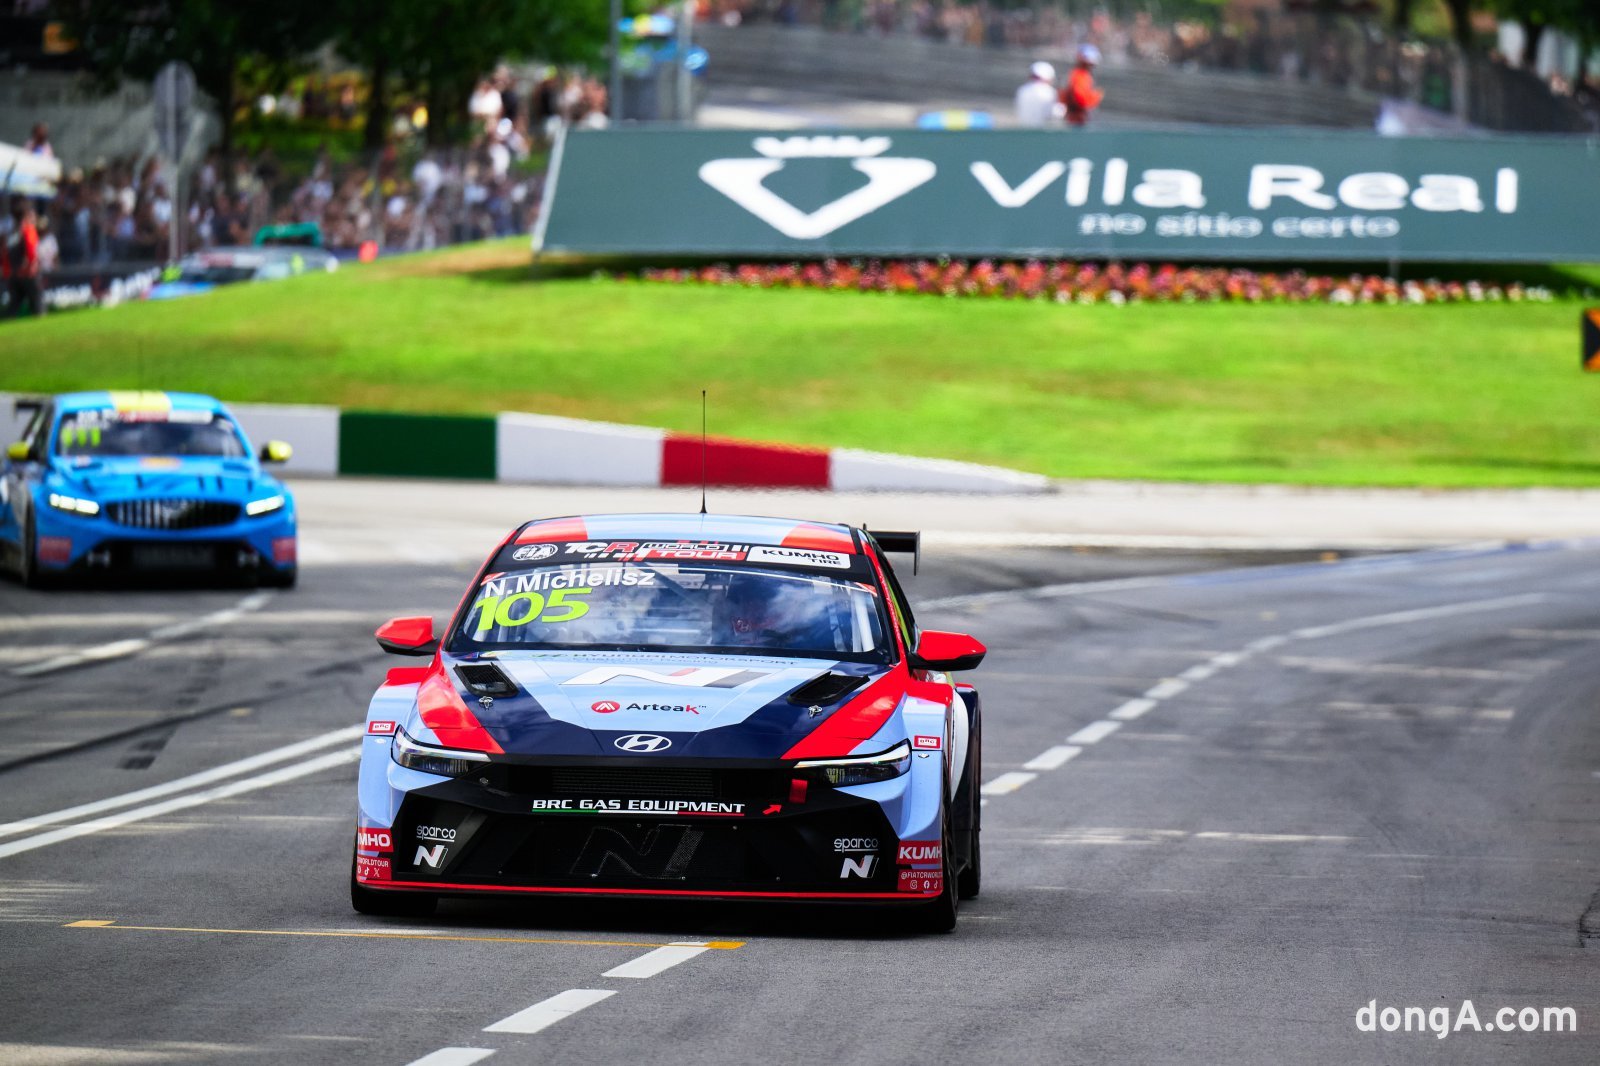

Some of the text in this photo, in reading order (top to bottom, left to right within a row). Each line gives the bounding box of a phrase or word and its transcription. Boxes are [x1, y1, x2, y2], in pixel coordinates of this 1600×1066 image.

[969, 156, 1519, 214] Vila Real
[1271, 214, 1400, 239] certo
[565, 542, 639, 554] TCR
[655, 550, 738, 560] TOUR
[762, 550, 840, 561] KUMHO
[808, 558, 842, 566] TIRE
[484, 569, 656, 597] N.Michelisz
[475, 588, 592, 631] 105
[532, 799, 746, 813] BRC GAS EQUIPMENT
[416, 825, 456, 840] sparco
[833, 838, 879, 853] sparco
